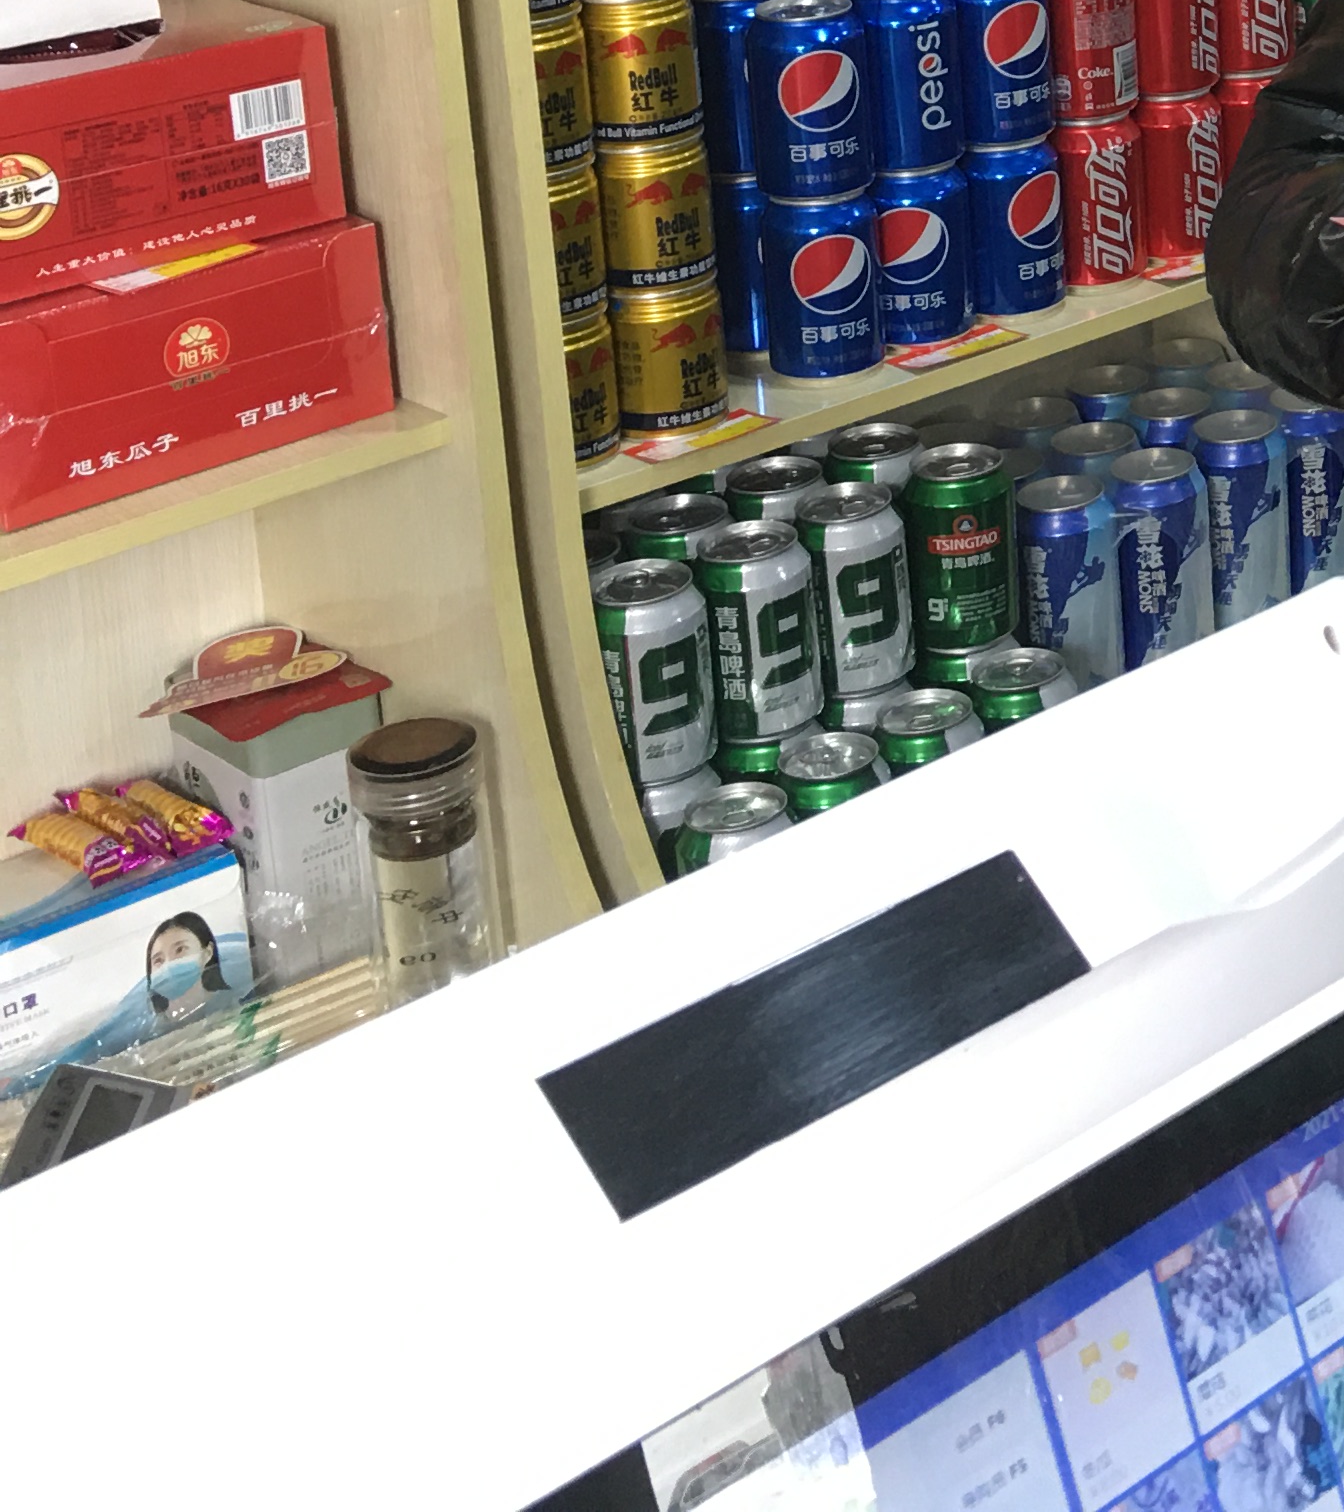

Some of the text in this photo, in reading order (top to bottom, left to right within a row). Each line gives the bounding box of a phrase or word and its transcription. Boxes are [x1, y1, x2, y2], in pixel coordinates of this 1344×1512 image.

[628, 63, 678, 92] RedBull
[909, 20, 952, 130] pepsi
[541, 88, 576, 114] edBull
[630, 88, 680, 112] 红牛
[995, 81, 1050, 109] 百事可乐
[789, 136, 860, 163] 百事可乐
[1086, 135, 1129, 275] 可口可乐
[655, 208, 700, 238] RedBull
[556, 236, 593, 266] edBull
[657, 232, 701, 258] 红牛
[880, 290, 947, 313] 百事可乐
[802, 317, 871, 344] 百事可乐
[177, 343, 220, 374] 旭东
[571, 382, 607, 412] edBull
[682, 370, 720, 399] 红牛
[235, 388, 339, 428] 百里挑一
[68, 432, 181, 479] 旭东瓜子
[932, 531, 998, 552] TSINGTAO
